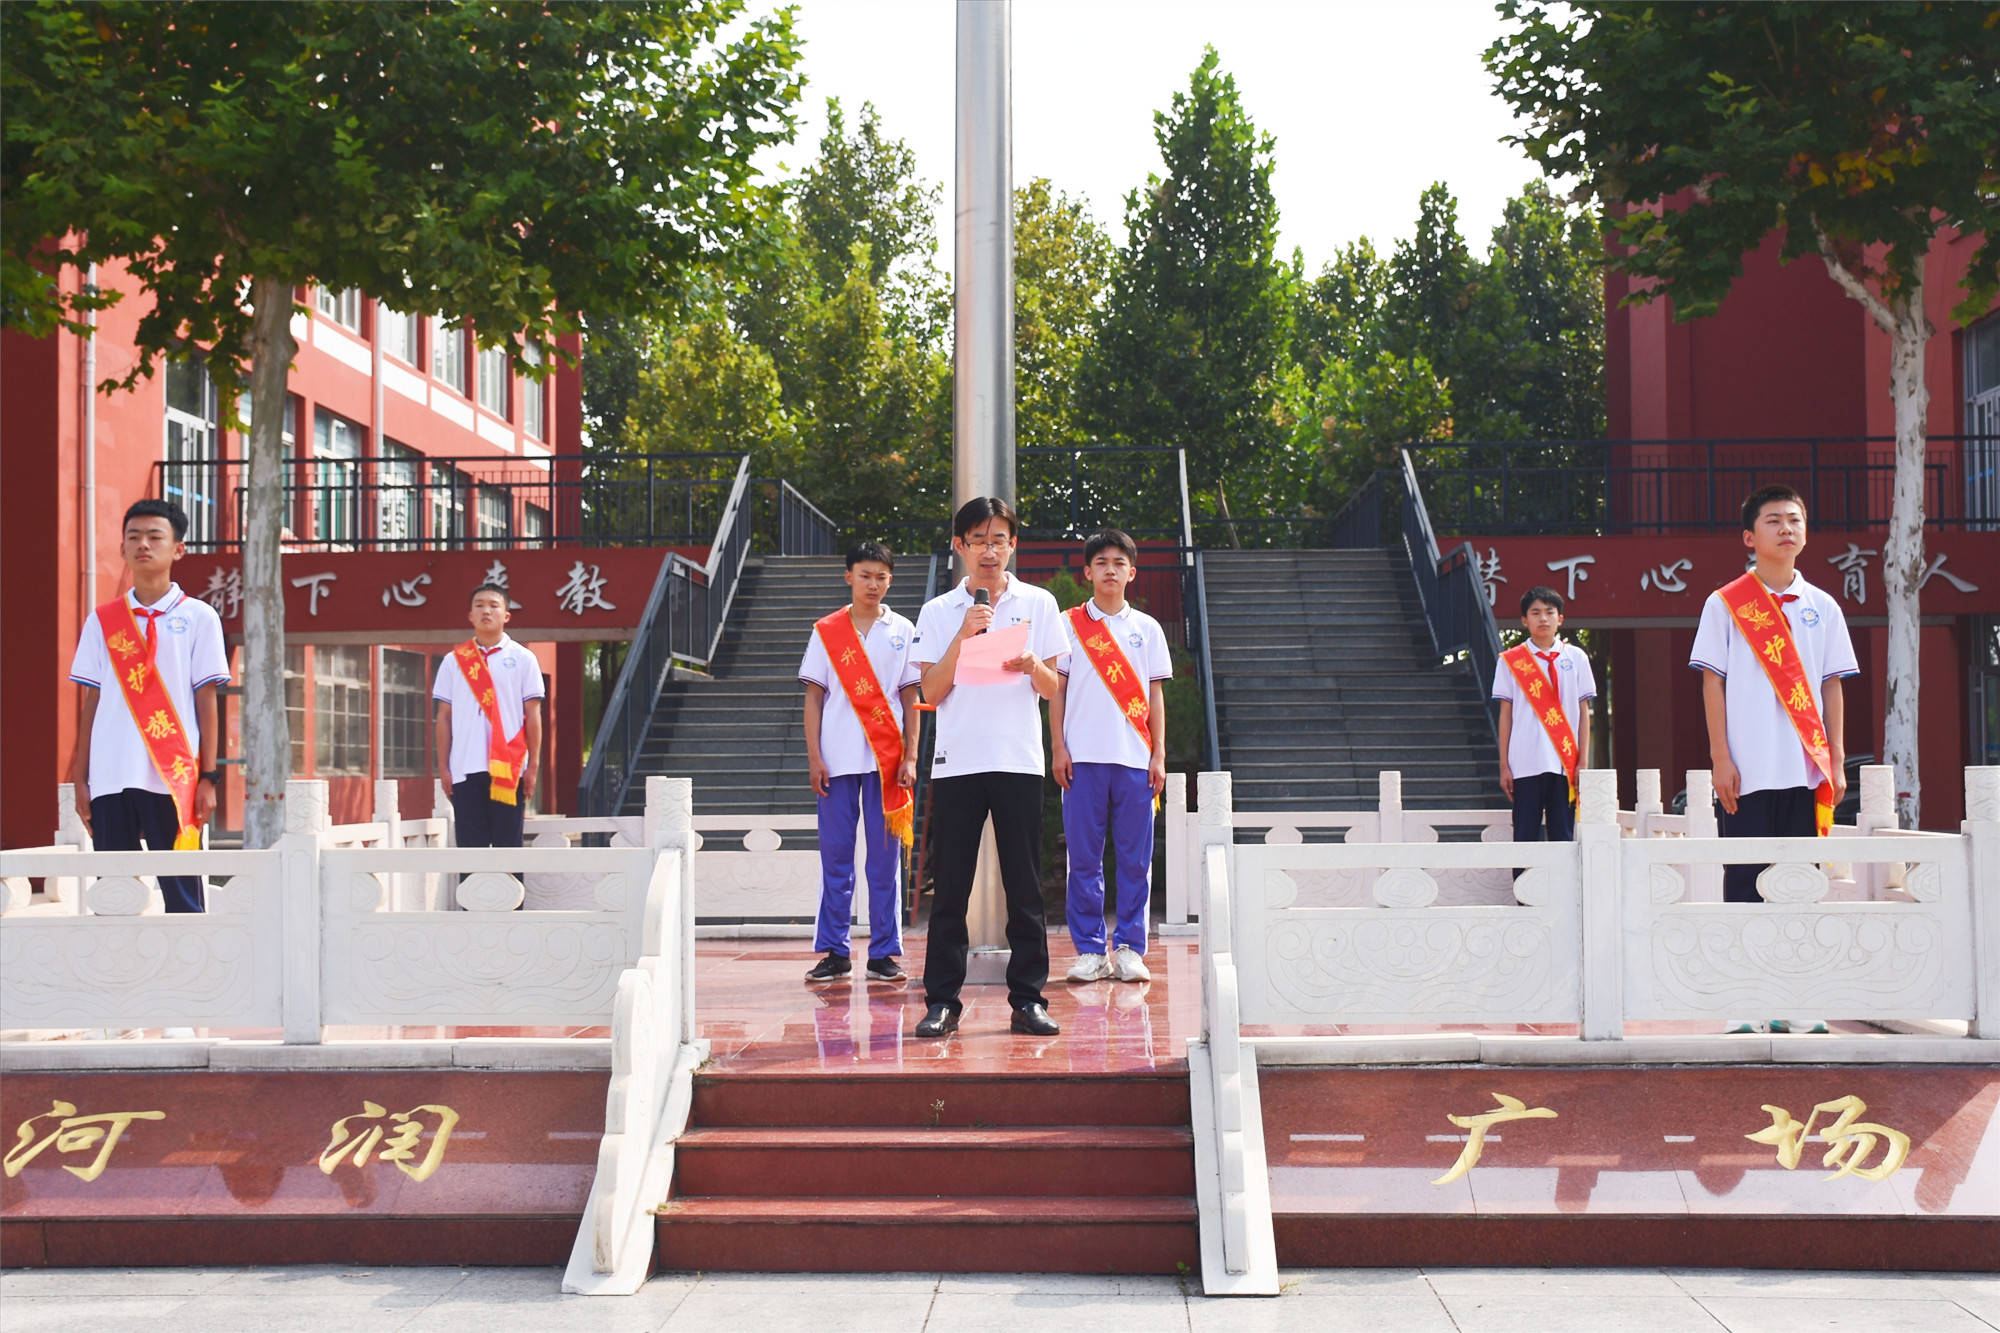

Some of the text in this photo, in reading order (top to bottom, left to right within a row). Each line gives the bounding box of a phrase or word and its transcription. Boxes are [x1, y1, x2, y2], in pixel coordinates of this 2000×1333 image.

[127, 663, 191, 784] 护旗手
[840, 646, 886, 725] 升旗手
[1529, 678, 1573, 756] 护旗手
[1763, 635, 1826, 752] 护旗手
[1431, 1092, 1910, 1184] 广场
